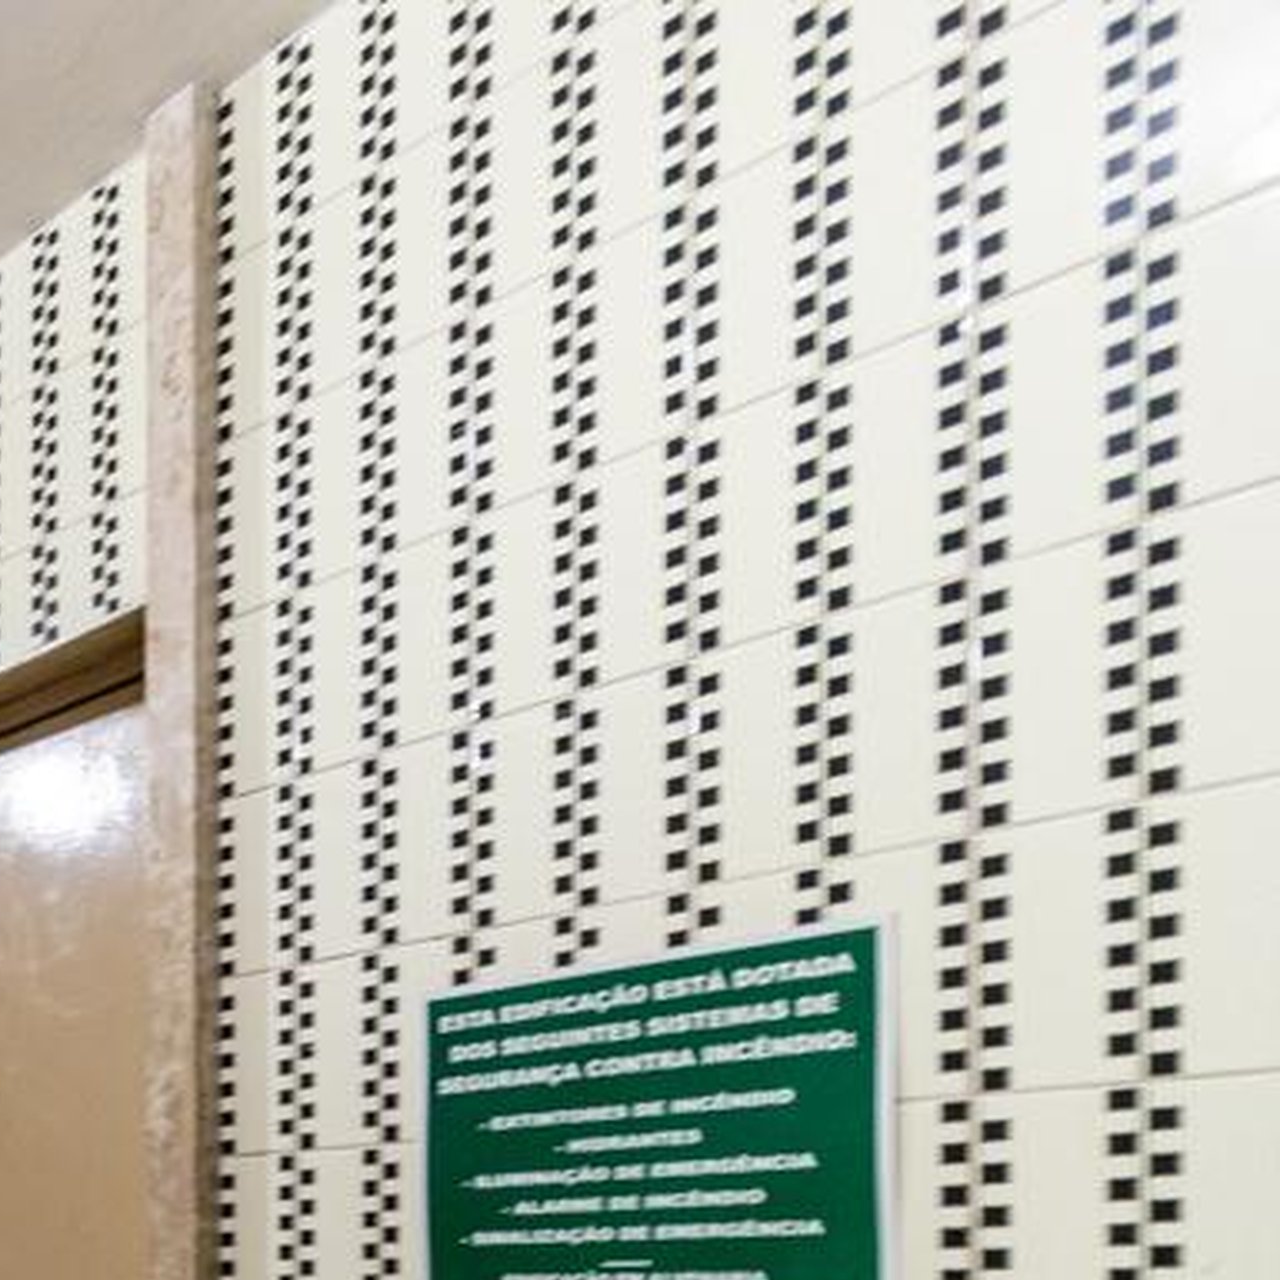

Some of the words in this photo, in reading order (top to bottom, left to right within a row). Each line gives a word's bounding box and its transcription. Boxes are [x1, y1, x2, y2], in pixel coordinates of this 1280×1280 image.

[437, 1009, 498, 1034] ESTA
[496, 984, 650, 1024] EDIFICAÇÃO
[651, 969, 728, 1001] ESTÁ
[731, 952, 856, 989] DOTADA
[448, 1040, 498, 1063] DOS
[794, 992, 839, 1017] DE
[583, 1048, 697, 1078] CONTRA
